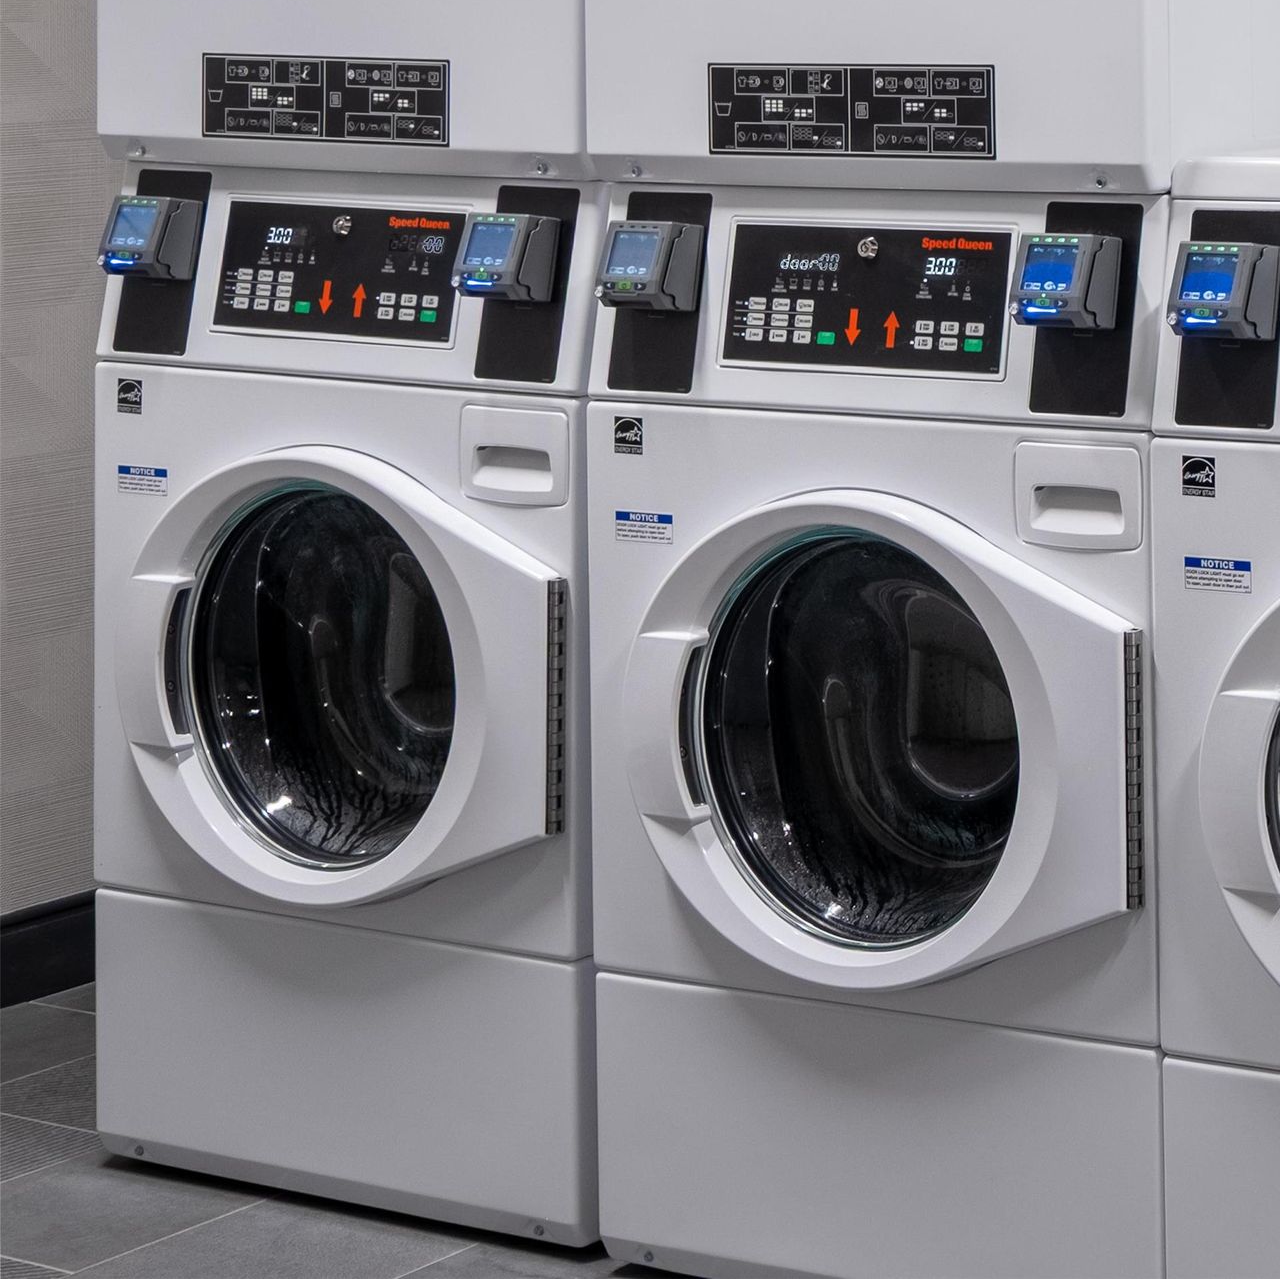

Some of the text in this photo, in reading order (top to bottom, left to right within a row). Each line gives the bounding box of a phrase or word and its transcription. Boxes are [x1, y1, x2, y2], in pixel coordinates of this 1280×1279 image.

[388, 216, 450, 229] Speed Queen
[266, 227, 293, 244] 3.00
[922, 237, 993, 250] Speed Queen
[925, 257, 956, 275] 3.00
[129, 466, 155, 476] NOTICE
[1183, 488, 1202, 496] ENERGY
[629, 513, 659, 522] NOTICE
[1201, 559, 1234, 570] NOTICE
